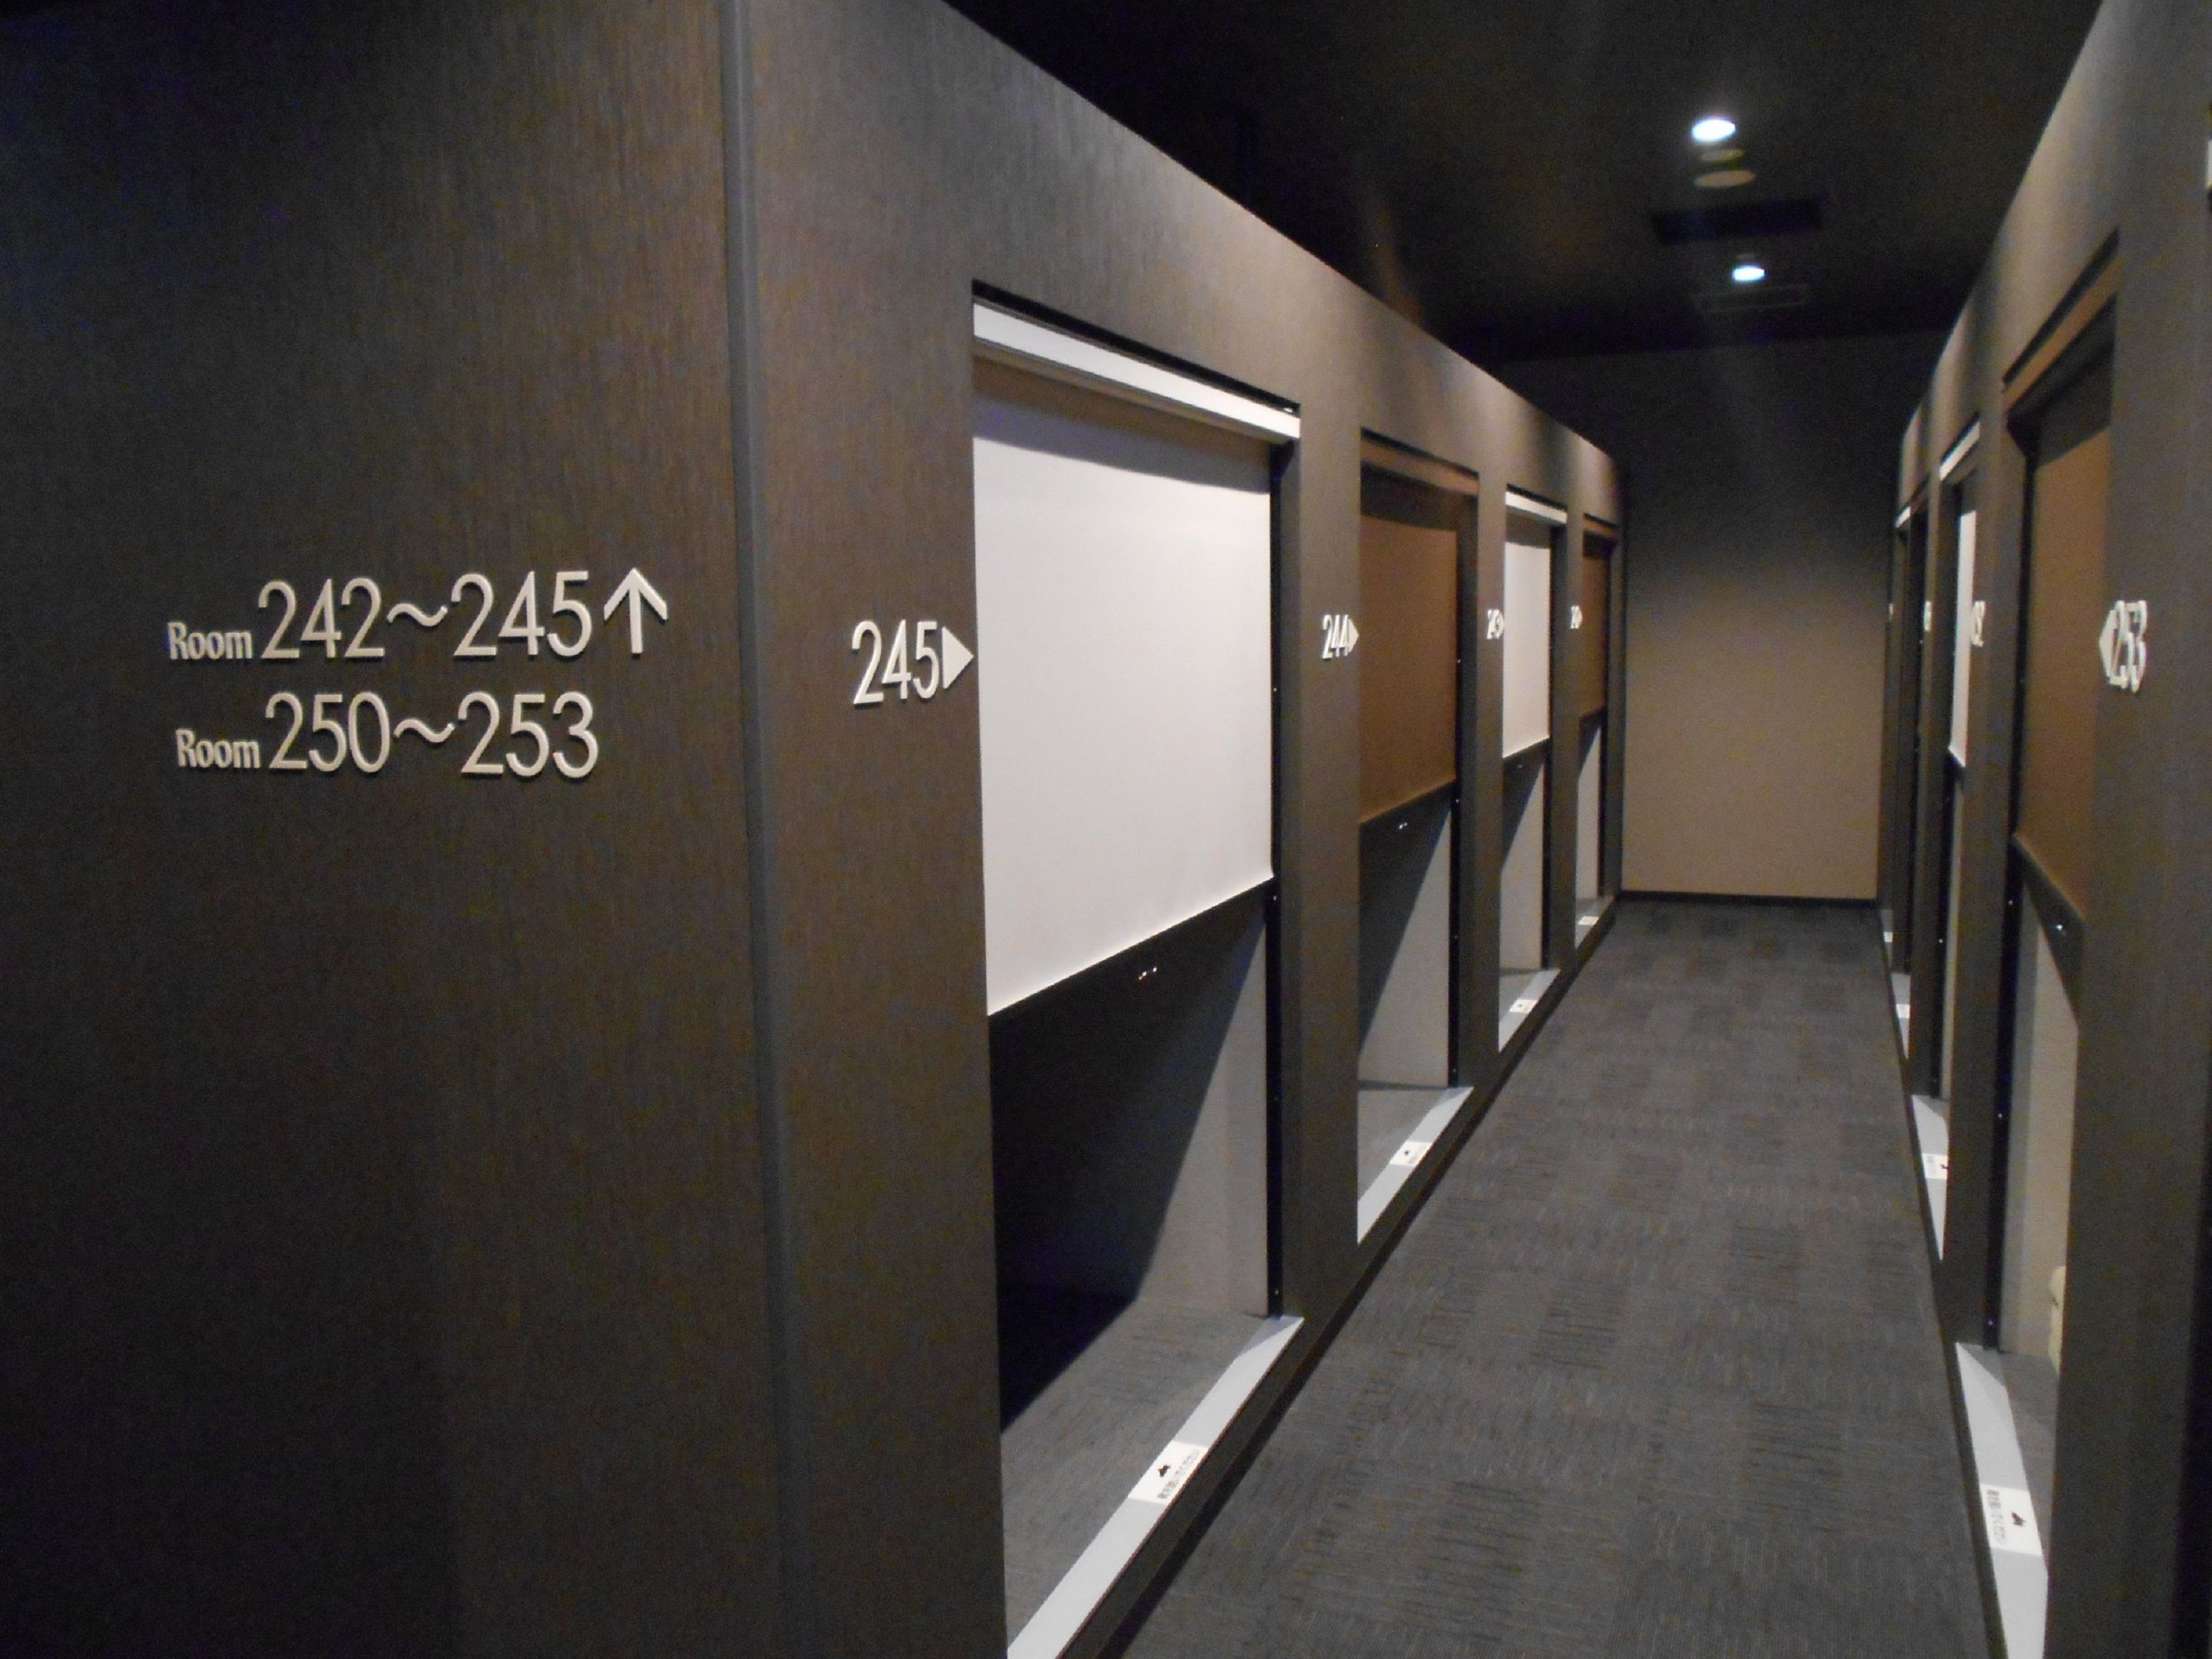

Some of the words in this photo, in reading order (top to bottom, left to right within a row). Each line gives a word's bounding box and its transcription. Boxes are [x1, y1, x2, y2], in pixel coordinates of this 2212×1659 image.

[167, 621, 252, 661] Room
[1322, 614, 1349, 659] 244
[852, 619, 939, 704] 245
[175, 728, 260, 768] Room
